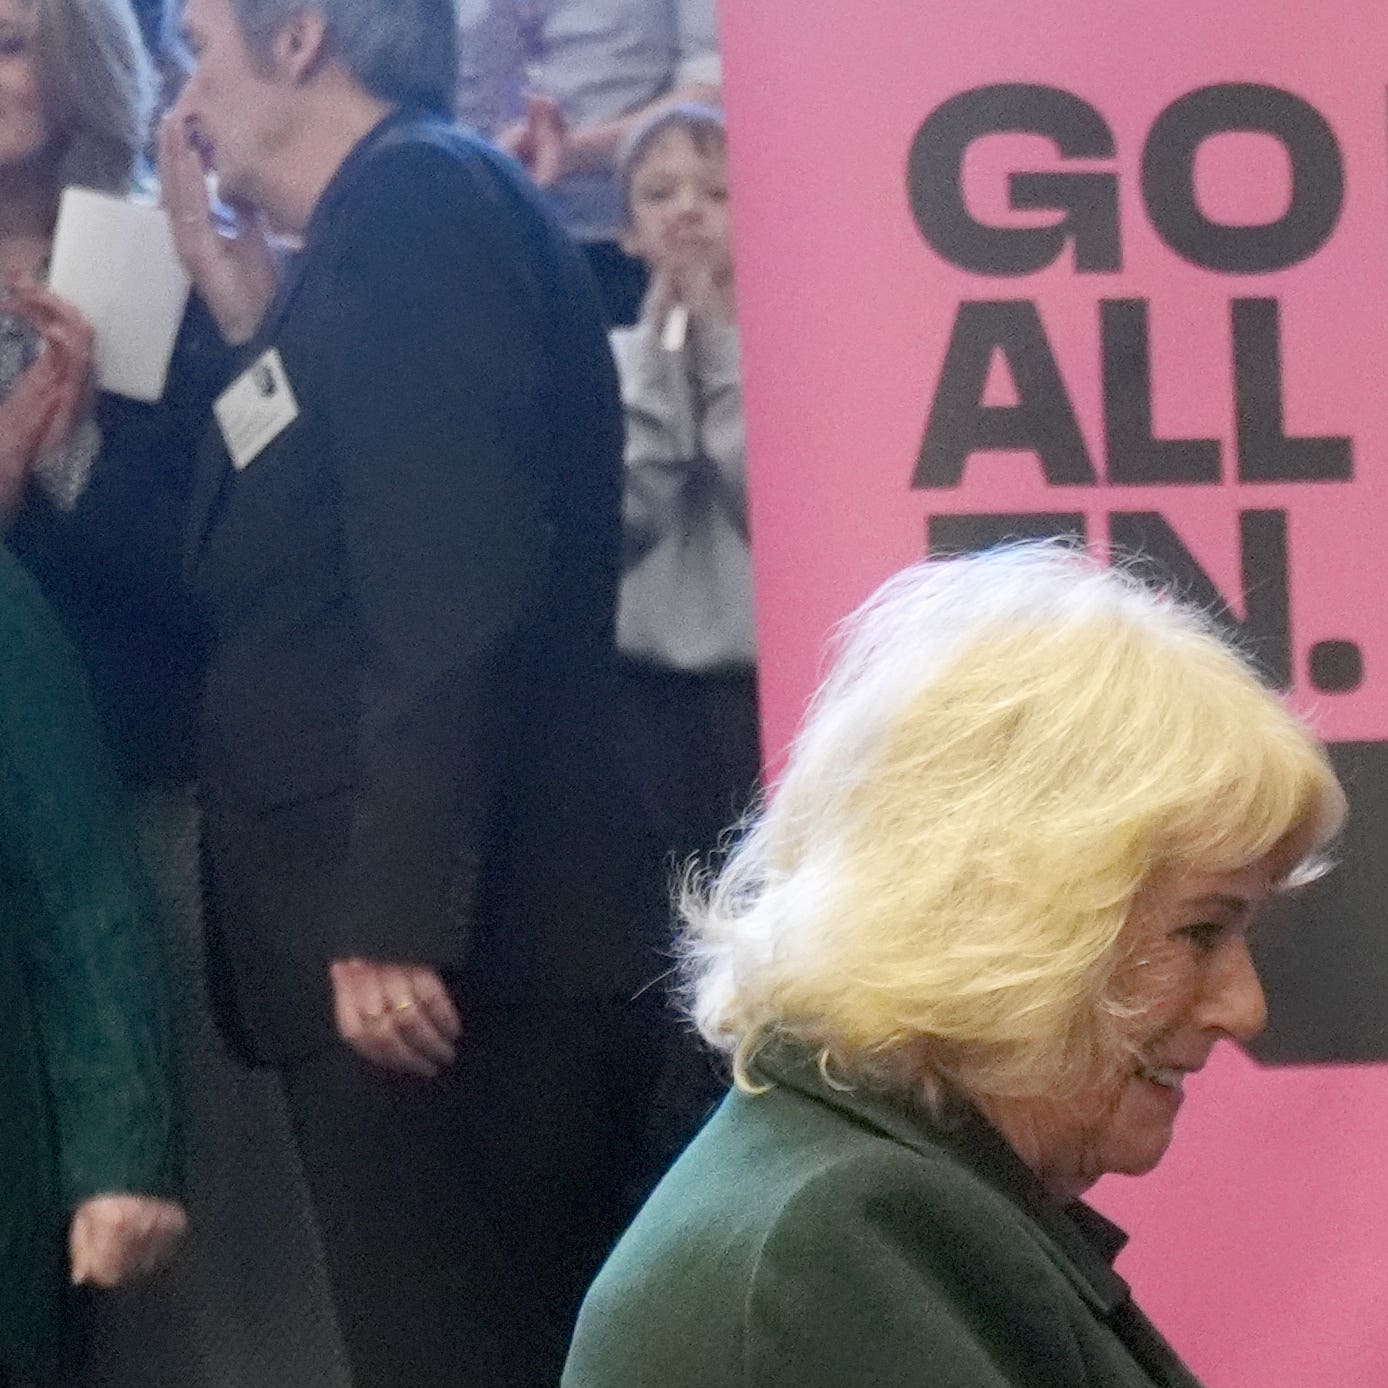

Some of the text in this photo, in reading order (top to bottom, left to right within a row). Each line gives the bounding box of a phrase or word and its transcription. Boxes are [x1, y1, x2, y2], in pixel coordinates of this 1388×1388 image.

[907, 82, 1345, 277] GO
[910, 296, 1354, 490] ALL
[927, 508, 1365, 696] N.
